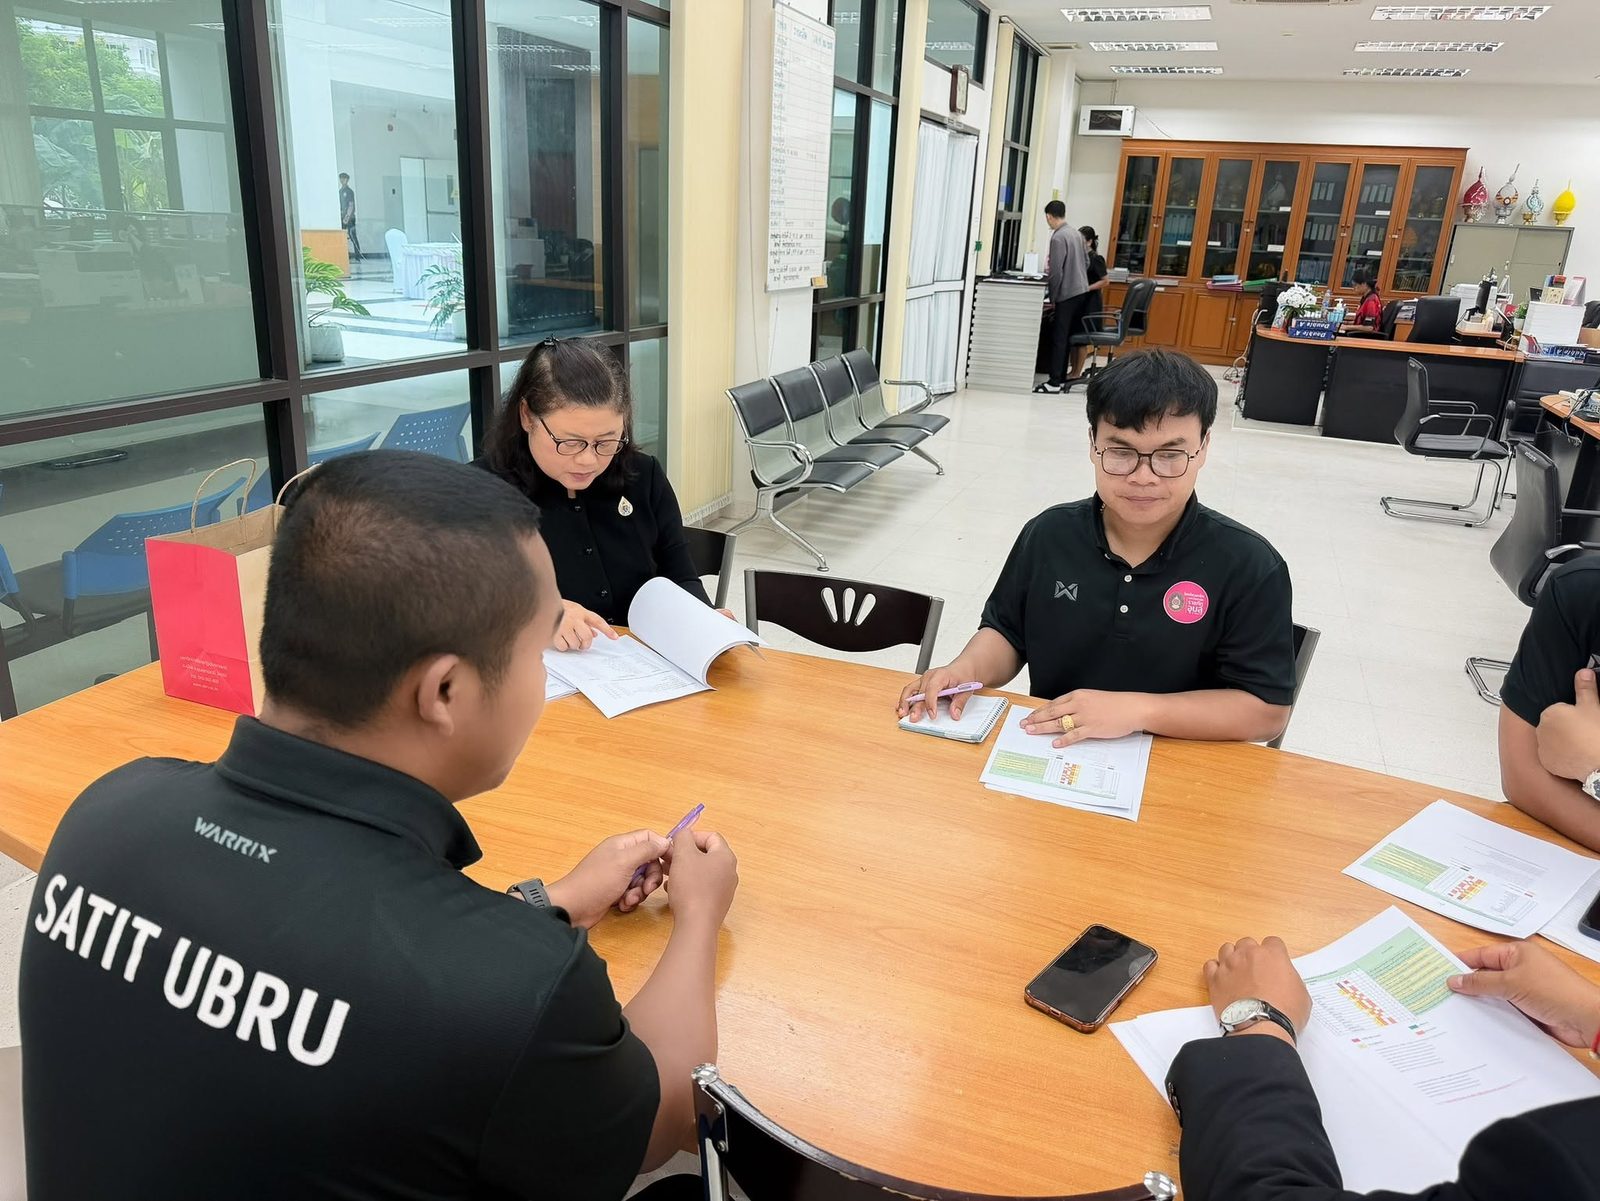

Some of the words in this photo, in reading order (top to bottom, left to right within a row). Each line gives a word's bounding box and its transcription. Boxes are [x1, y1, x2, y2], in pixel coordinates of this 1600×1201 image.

[1303, 330, 1326, 338] Double
[194, 817, 278, 863] WARRIX
[35, 873, 162, 983] SATIT
[163, 937, 350, 1066] UBRU
